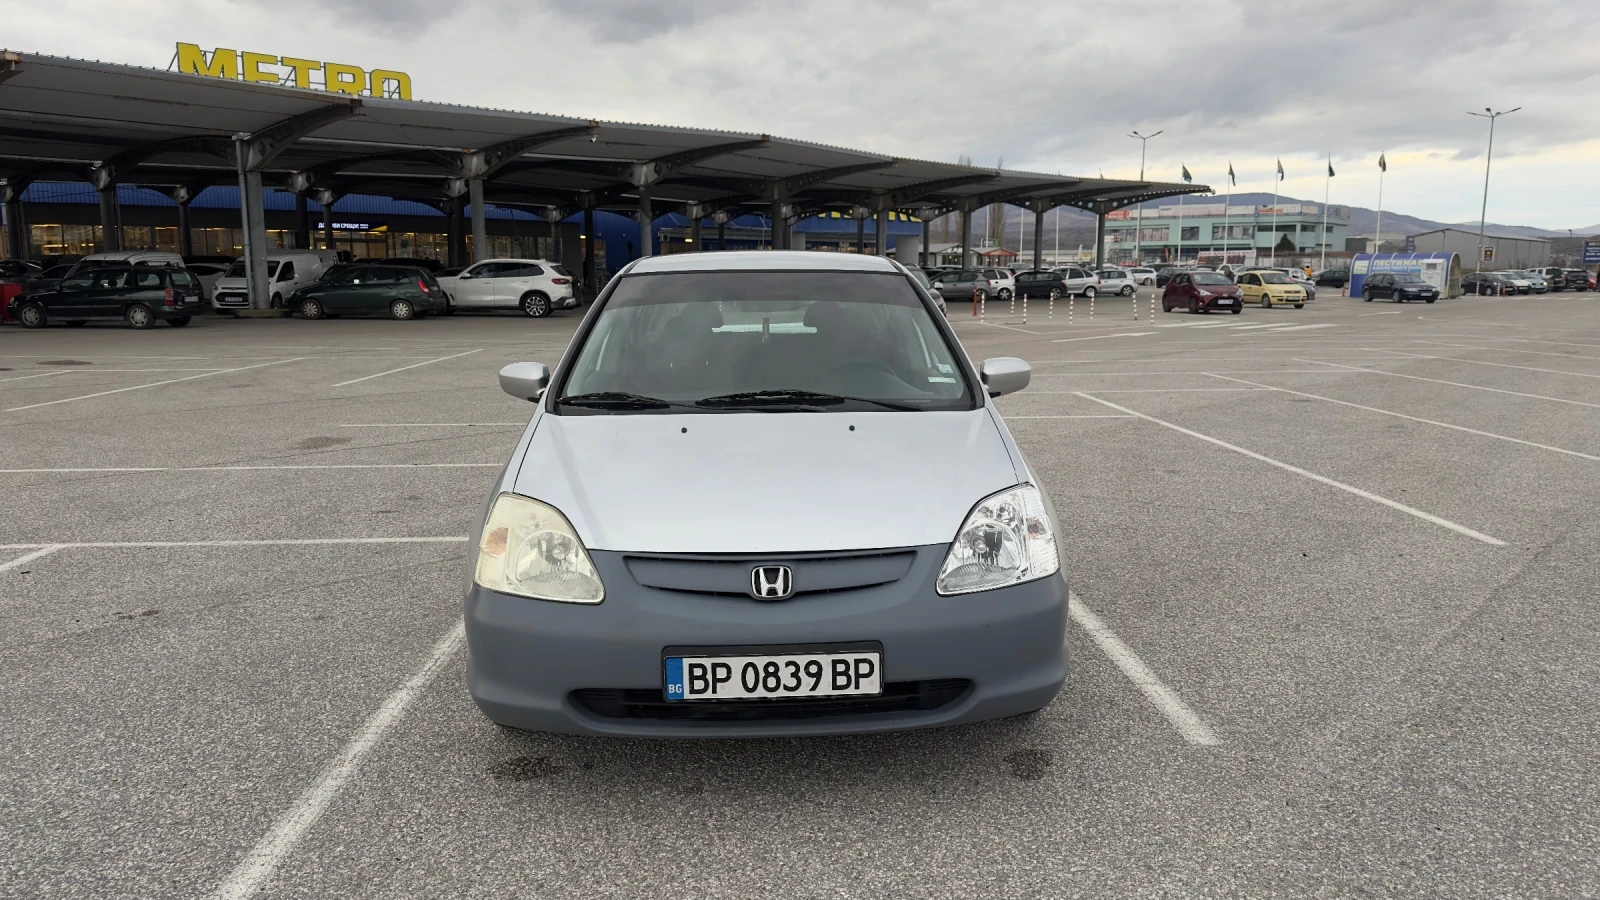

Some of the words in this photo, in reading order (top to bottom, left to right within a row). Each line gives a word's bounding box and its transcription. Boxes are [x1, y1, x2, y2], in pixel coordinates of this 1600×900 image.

[175, 42, 412, 101] METRO
[668, 684, 682, 694] BG
[688, 662, 732, 695] BP
[740, 659, 823, 693] 0839
[831, 658, 875, 691] BP
